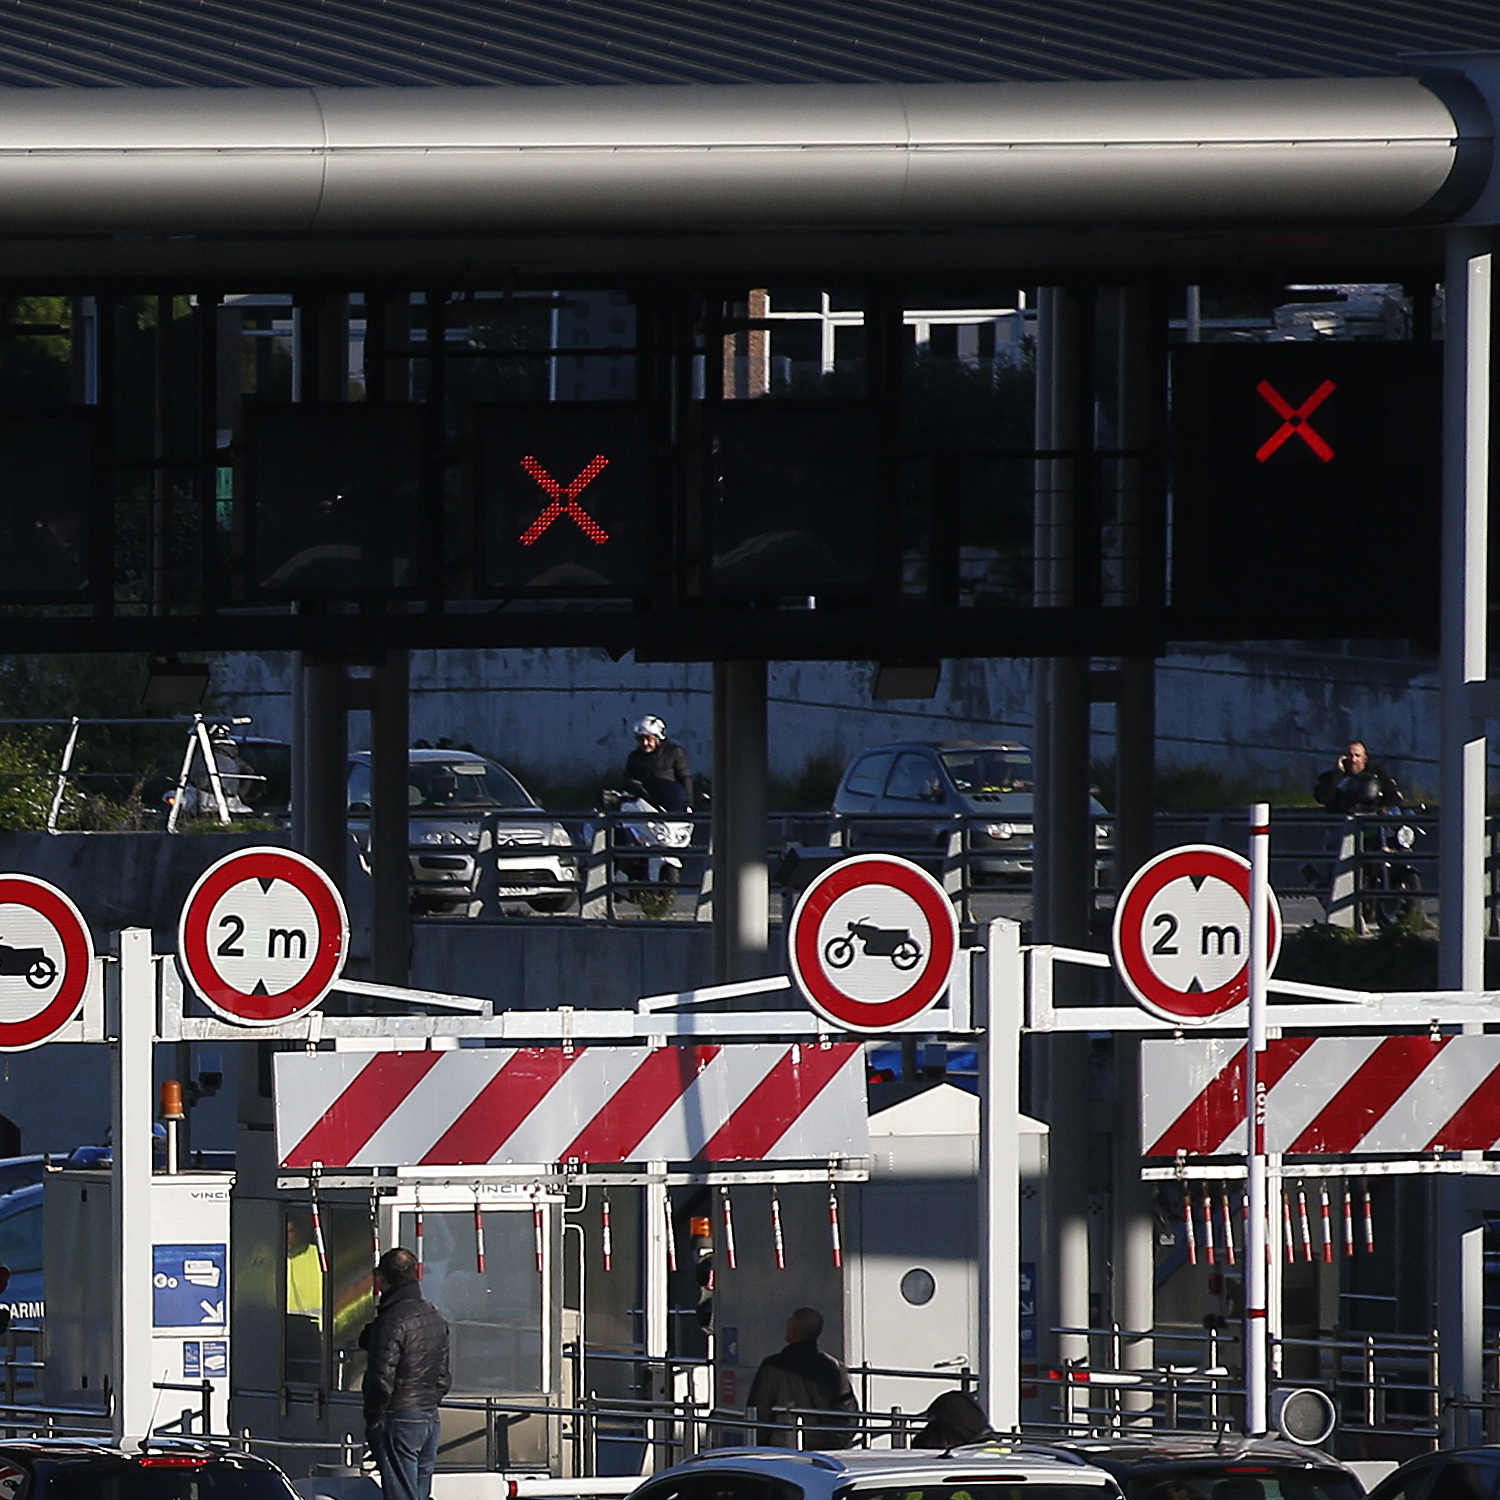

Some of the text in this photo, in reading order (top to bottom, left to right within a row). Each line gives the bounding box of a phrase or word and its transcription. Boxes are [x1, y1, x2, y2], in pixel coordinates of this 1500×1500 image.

[217, 914, 307, 958] 2 m
[1152, 913, 1241, 955] 2 m
[1256, 1082, 1267, 1125] STOP
